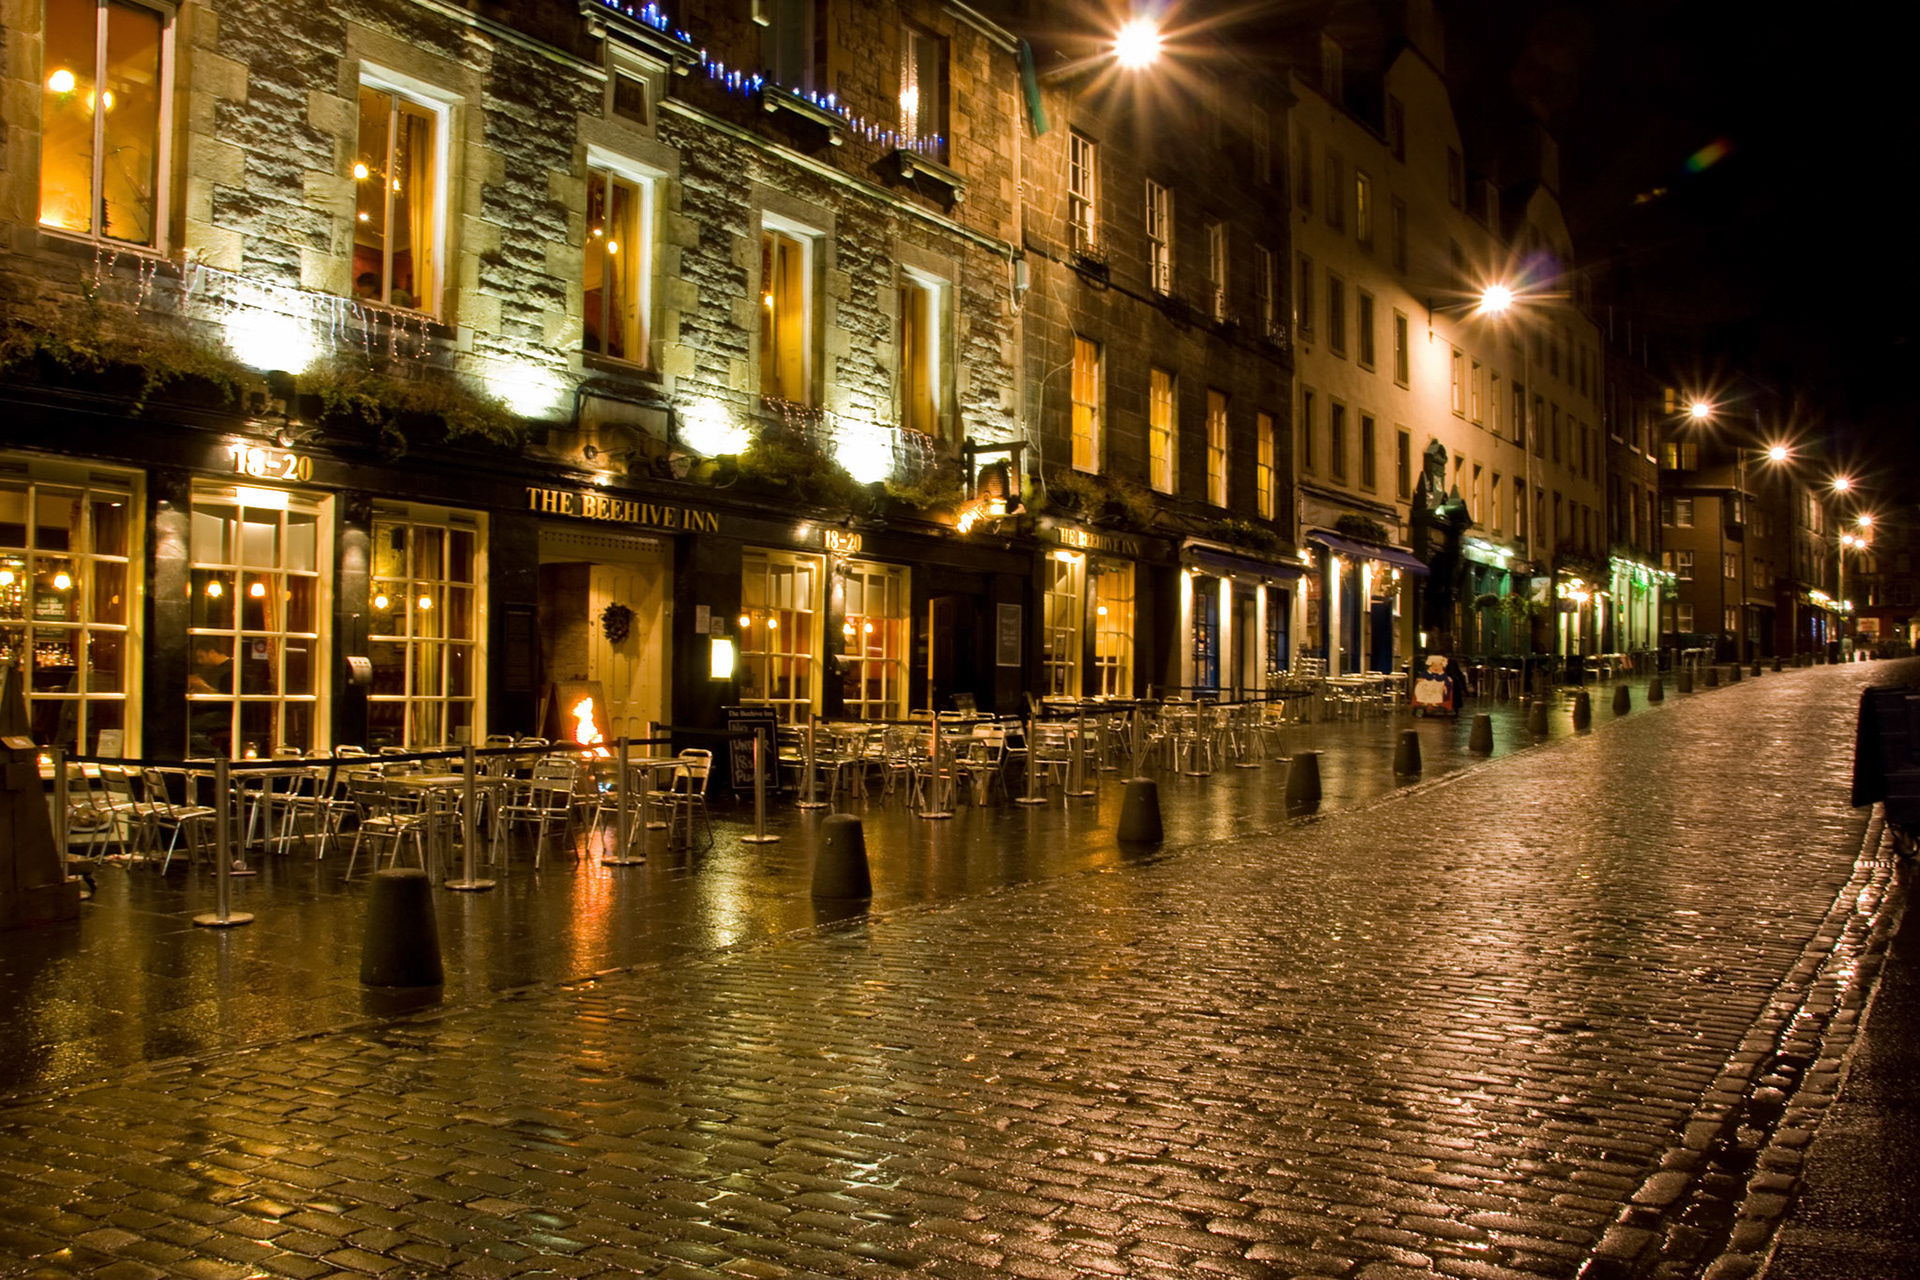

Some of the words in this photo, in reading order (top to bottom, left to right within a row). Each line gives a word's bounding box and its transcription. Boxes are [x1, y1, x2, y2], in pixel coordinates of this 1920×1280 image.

[229, 444, 313, 481] 18-20
[526, 487, 574, 515] THE
[581, 494, 676, 528] BEEHIVE
[683, 509, 720, 533] INN
[825, 530, 862, 552] 18-20
[1058, 527, 1076, 546] HE
[733, 739, 773, 754] UNDR
